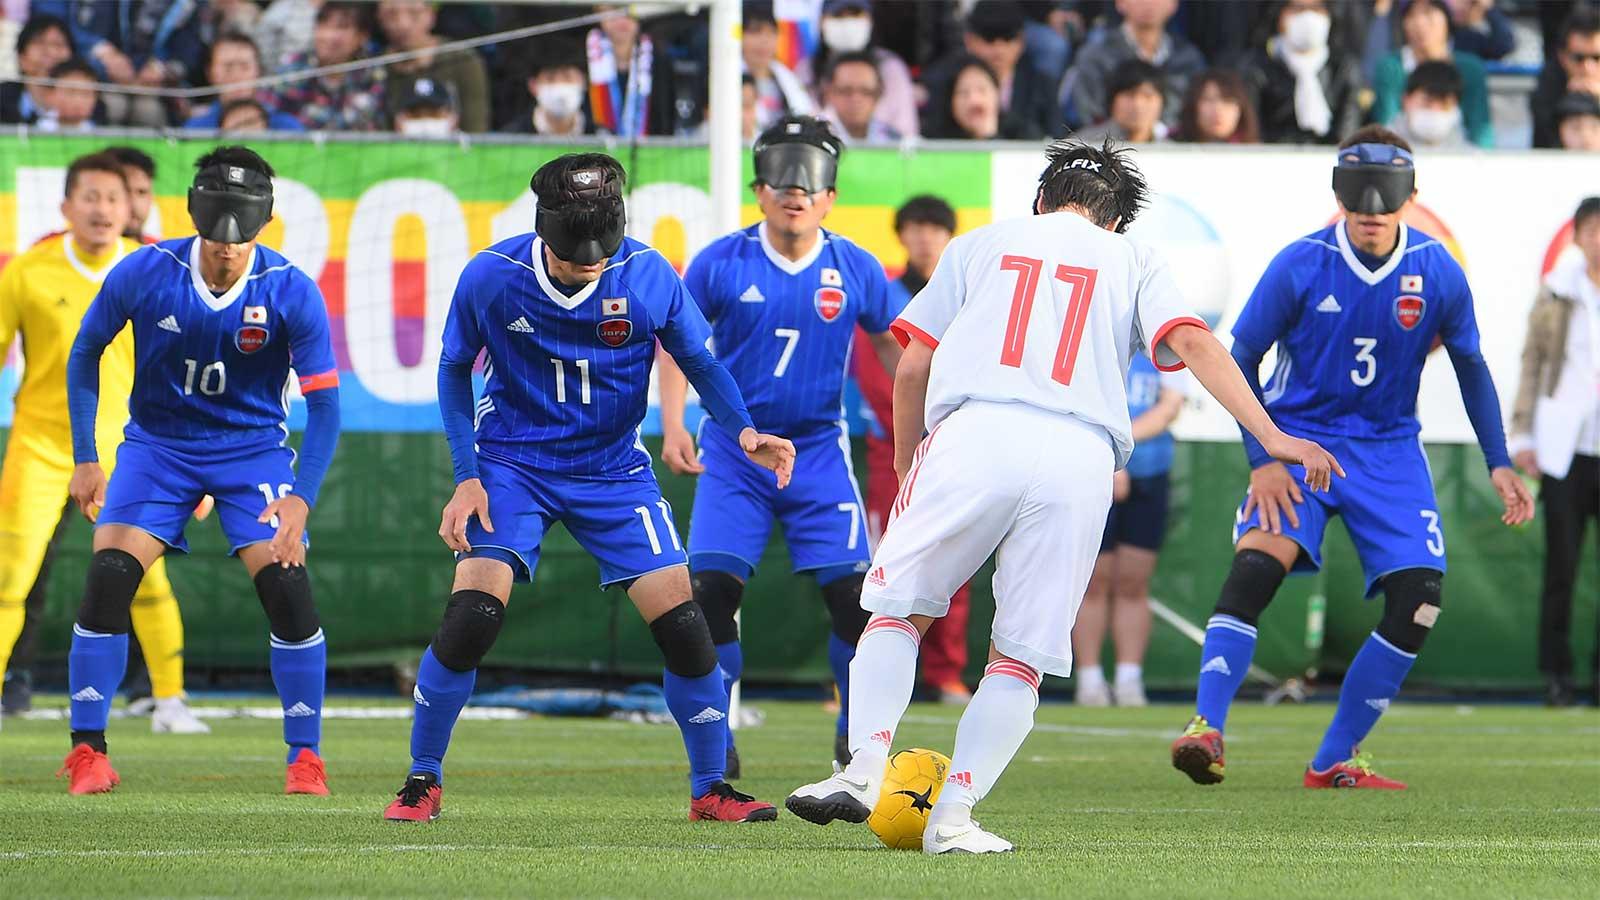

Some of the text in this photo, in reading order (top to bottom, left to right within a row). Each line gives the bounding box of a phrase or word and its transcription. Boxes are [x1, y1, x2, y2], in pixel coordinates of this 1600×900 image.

[1000, 255, 1098, 386] 11
[184, 358, 227, 396] 10
[773, 328, 800, 378] 7
[1350, 337, 1377, 387] 3
[550, 358, 591, 405] 11
[634, 501, 681, 555] 11
[838, 502, 860, 550] 7
[1420, 509, 1445, 558] 3
